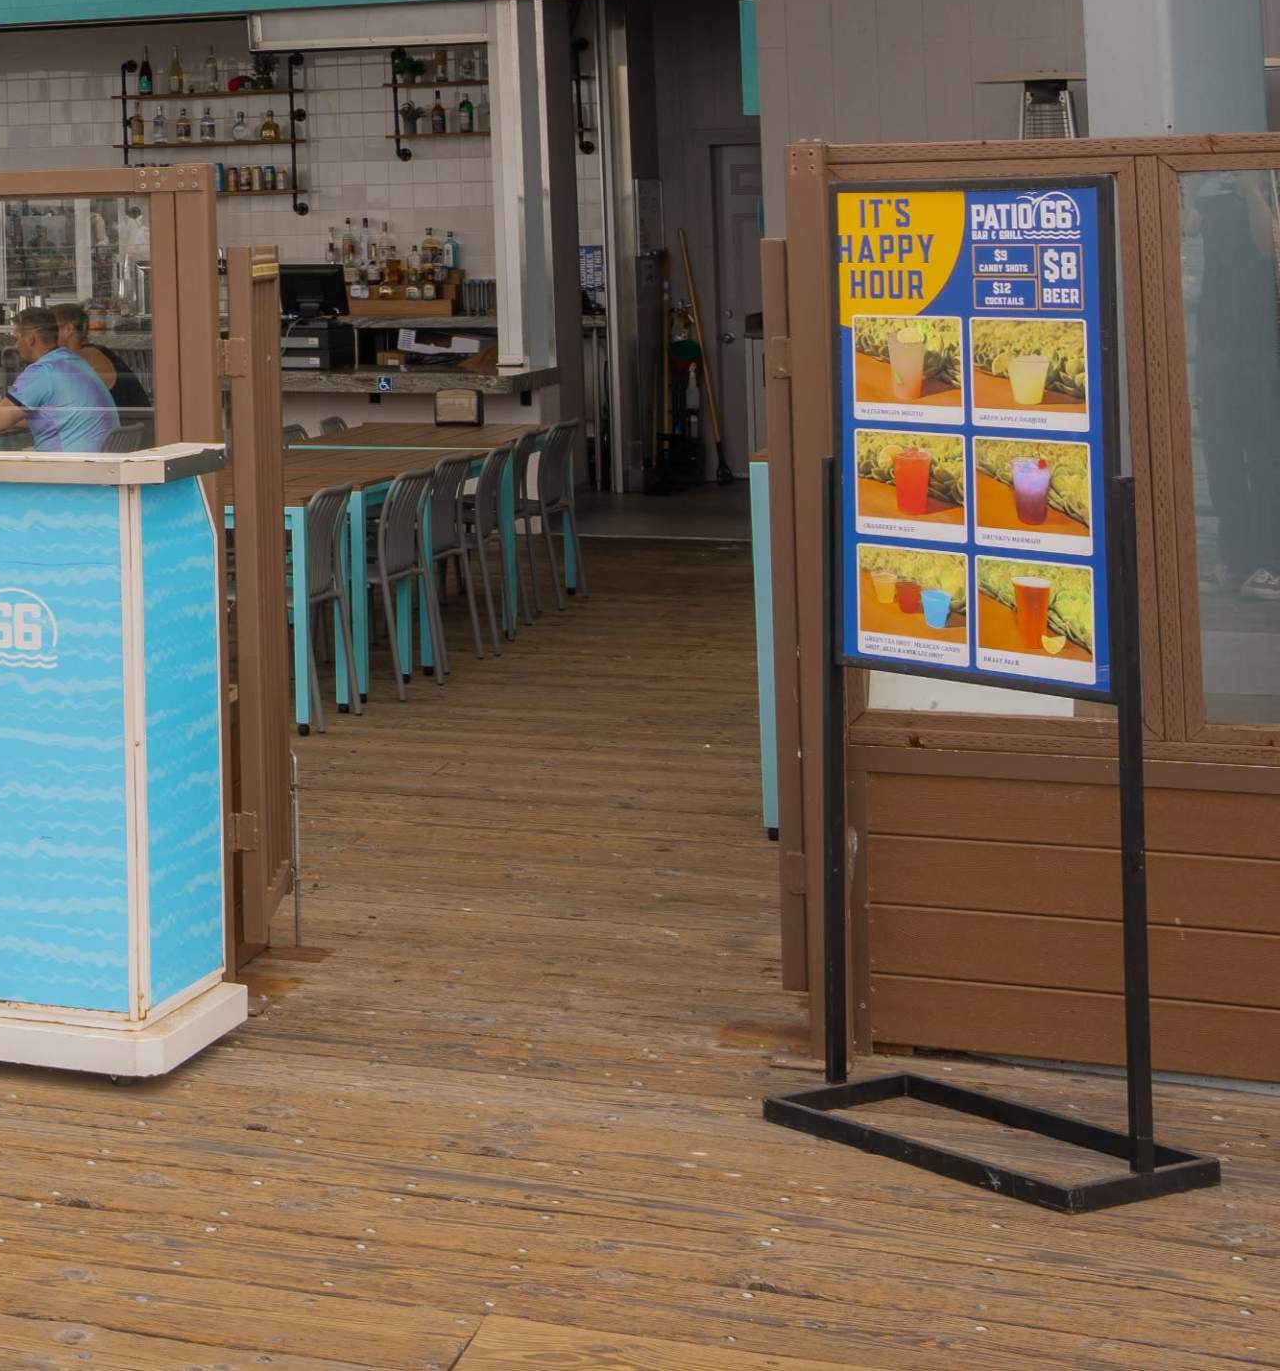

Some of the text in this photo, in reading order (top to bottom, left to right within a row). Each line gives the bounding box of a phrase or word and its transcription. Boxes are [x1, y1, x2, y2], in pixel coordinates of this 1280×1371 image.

[859, 198, 911, 228] IT'S
[970, 200, 1073, 230] PATIO 66
[971, 230, 989, 240] BAR
[999, 231, 1024, 240] GRILL
[838, 234, 935, 263] HAPPY
[994, 249, 1008, 262] $9
[979, 264, 1028, 273] CANDY SHOTS
[1043, 249, 1077, 283] $8
[850, 270, 925, 299] HOUR
[992, 282, 1012, 294] $12
[984, 296, 1024, 306] COCKTAILS
[1043, 288, 1079, 304] BEER
